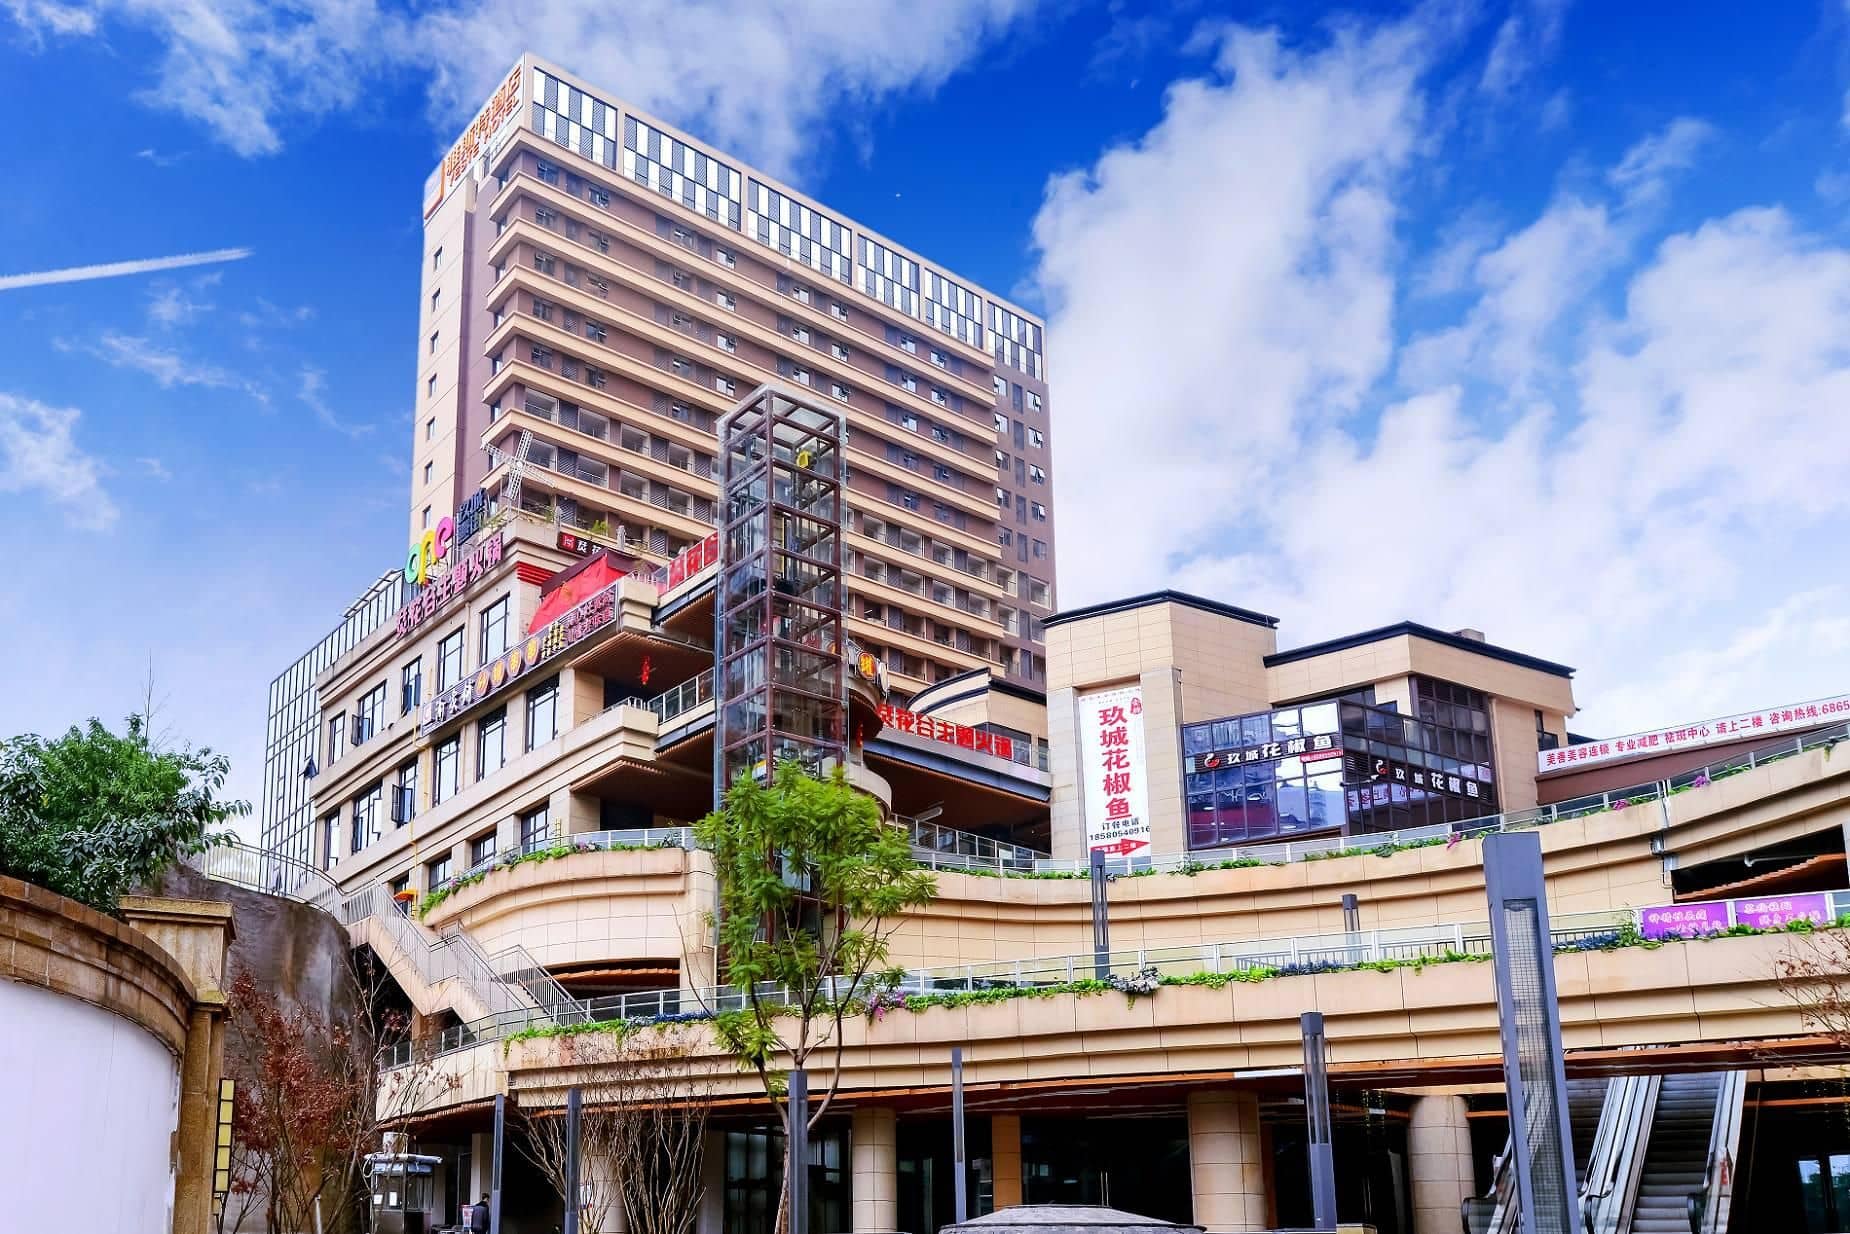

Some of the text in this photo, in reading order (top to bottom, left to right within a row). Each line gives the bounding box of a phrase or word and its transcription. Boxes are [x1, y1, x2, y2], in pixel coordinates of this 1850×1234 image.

[484, 98, 520, 144] HOTEL
[1097, 704, 1133, 821] 玖城花椒鱼
[1227, 735, 1332, 765] 玖城花椒鱼
